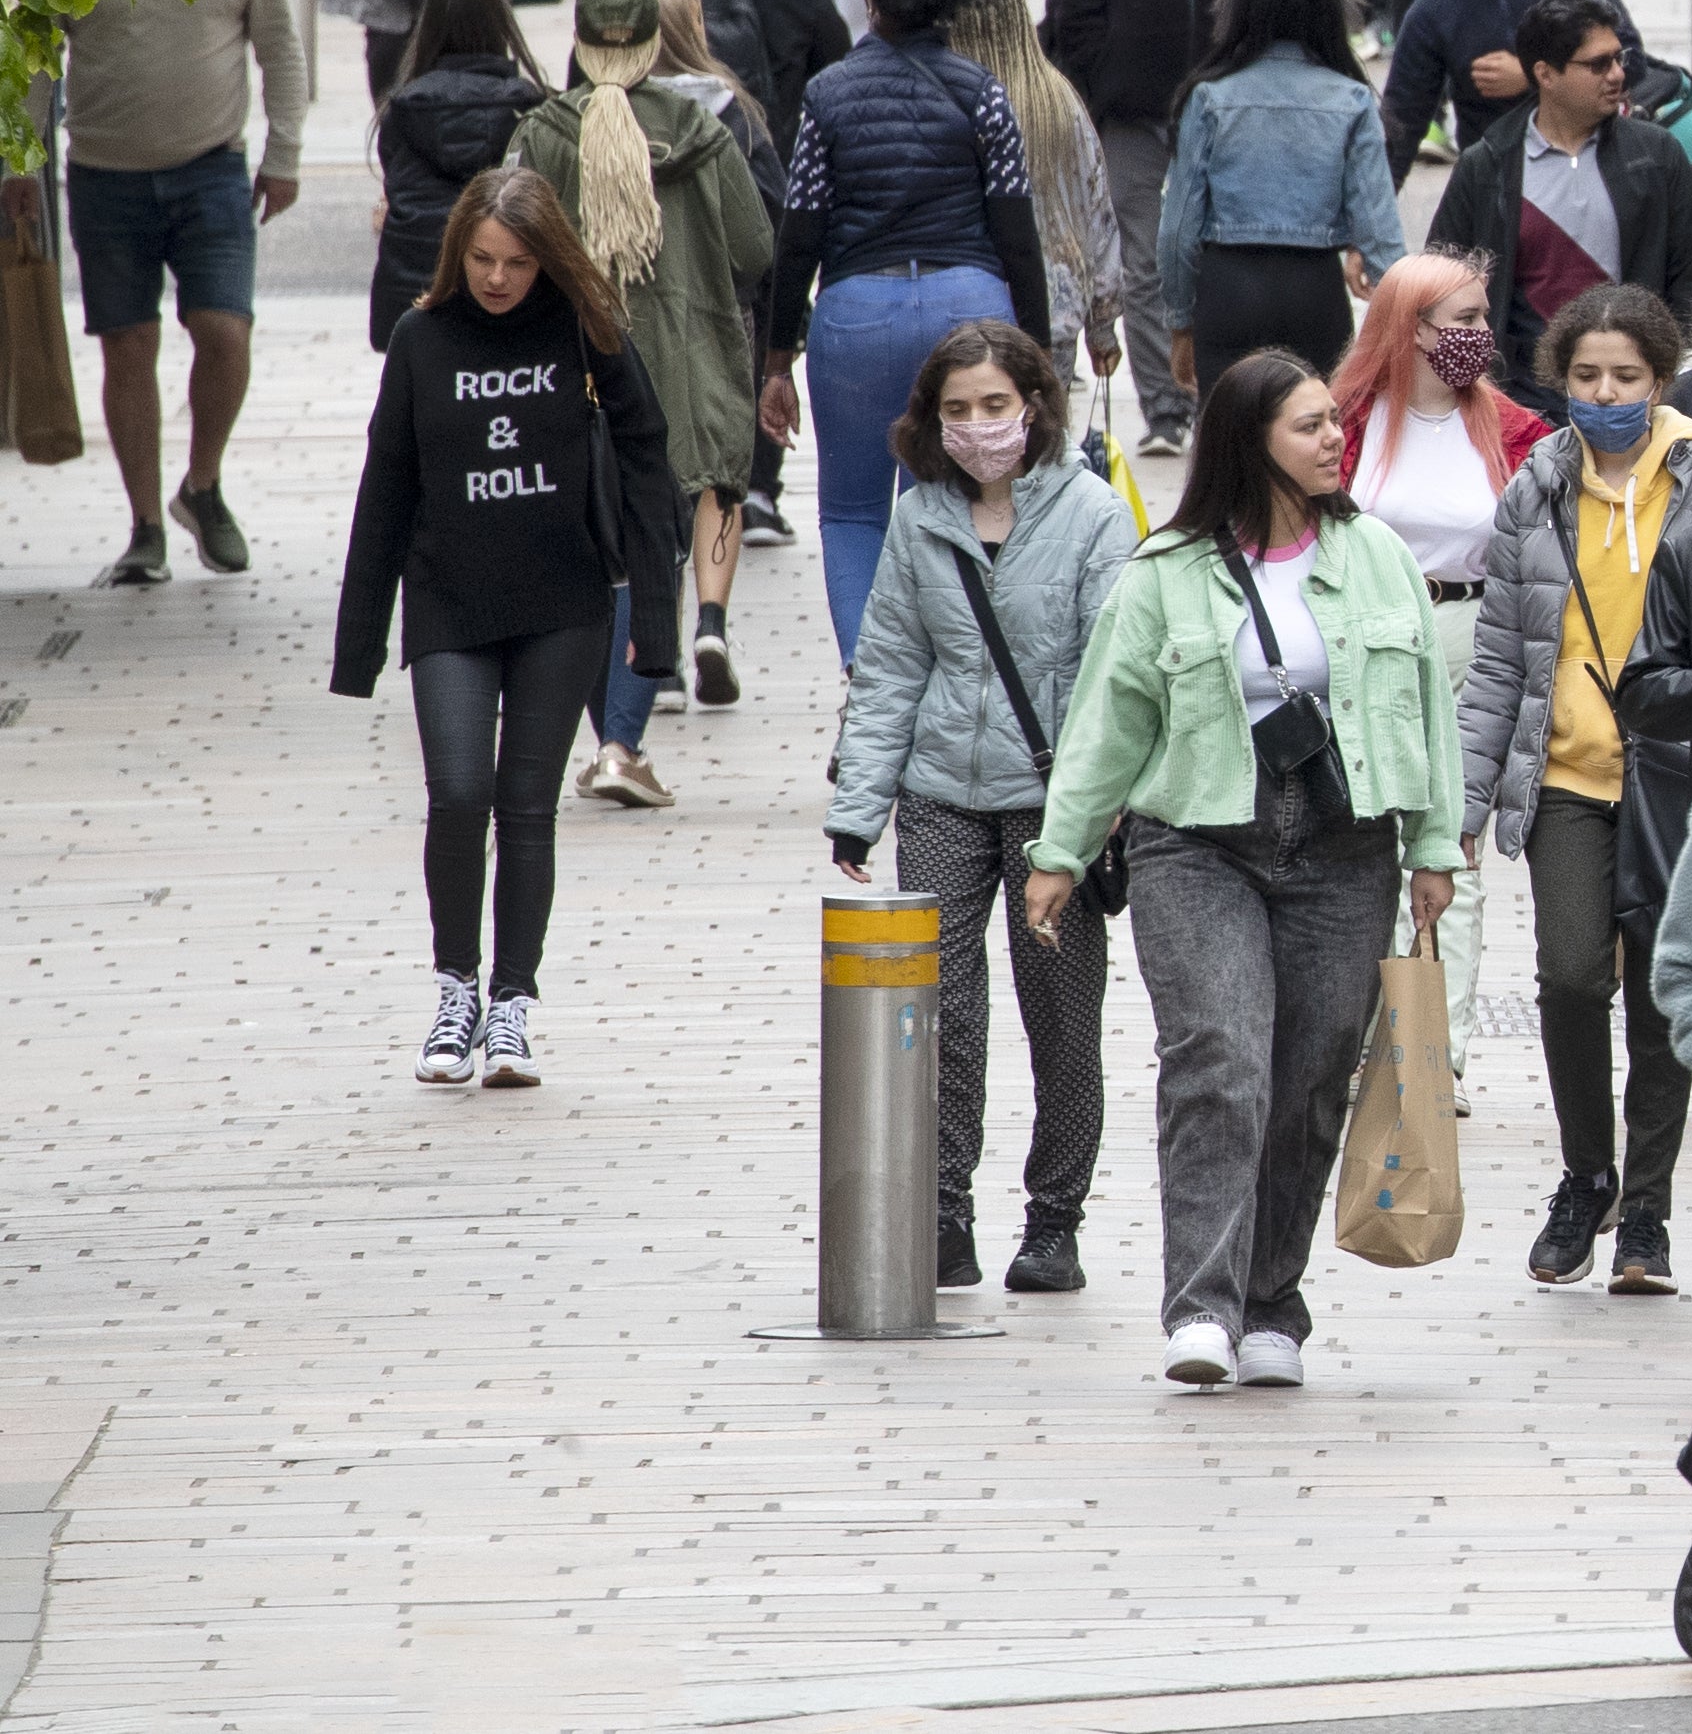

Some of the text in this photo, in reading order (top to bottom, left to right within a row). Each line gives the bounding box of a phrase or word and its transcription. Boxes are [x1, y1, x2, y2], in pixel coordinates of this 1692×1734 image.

[455, 363, 557, 402] ROCK
[487, 415, 520, 450] &
[466, 463, 558, 503] ROLL
